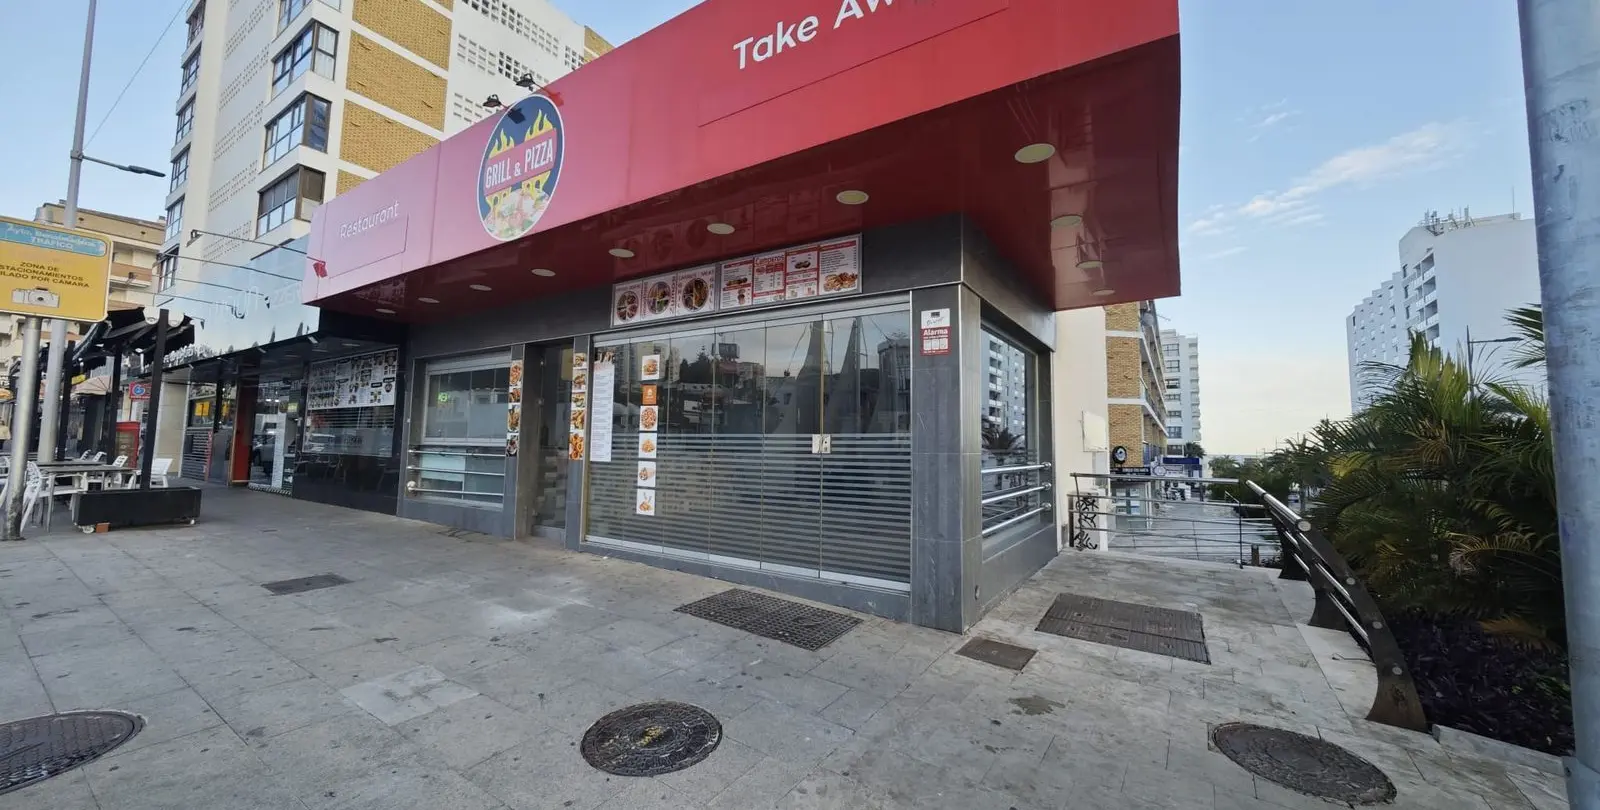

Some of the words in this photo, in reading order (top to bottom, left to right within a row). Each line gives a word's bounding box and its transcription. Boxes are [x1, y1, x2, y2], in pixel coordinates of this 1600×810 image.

[733, 15, 819, 70] Take
[485, 158, 512, 189] GRILL
[514, 162, 522, 178] &
[524, 138, 554, 173] PIZZA
[340, 200, 400, 239] Restaurant
[20, 261, 46, 271] ZONA
[47, 265, 60, 273] DE
[31, 275, 50, 283] POR
[923, 328, 949, 336] Alarma
